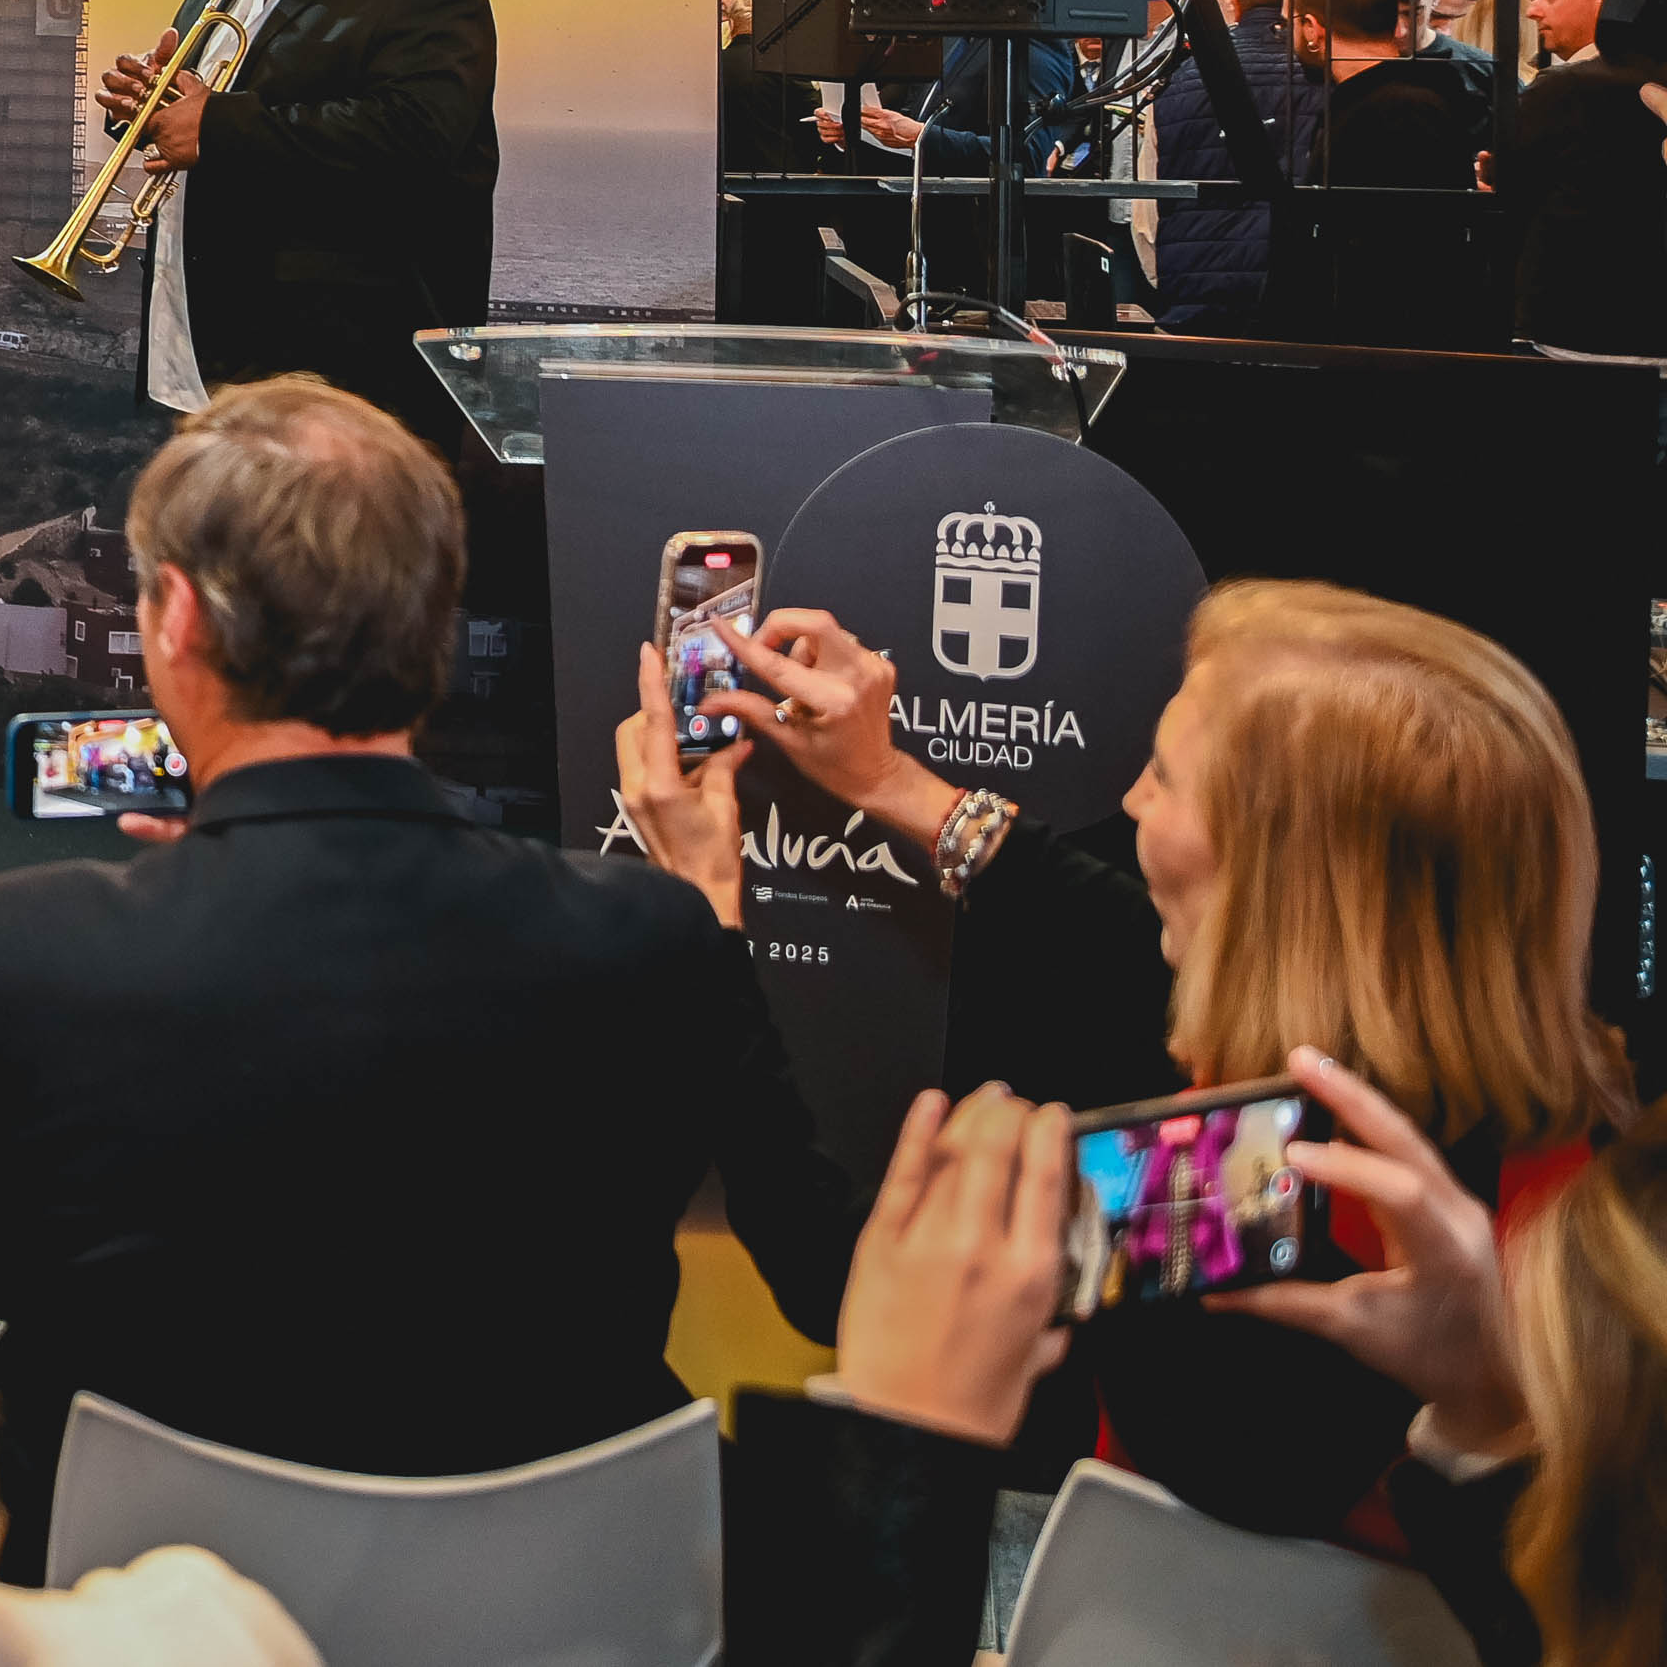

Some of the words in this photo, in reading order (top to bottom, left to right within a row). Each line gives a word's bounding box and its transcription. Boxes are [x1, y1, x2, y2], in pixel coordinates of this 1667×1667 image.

[888, 694, 1086, 749] ALMERÍA
[928, 737, 1033, 770] CIUDAD
[595, 788, 920, 885] Aalucía
[769, 942, 829, 965] 2025
